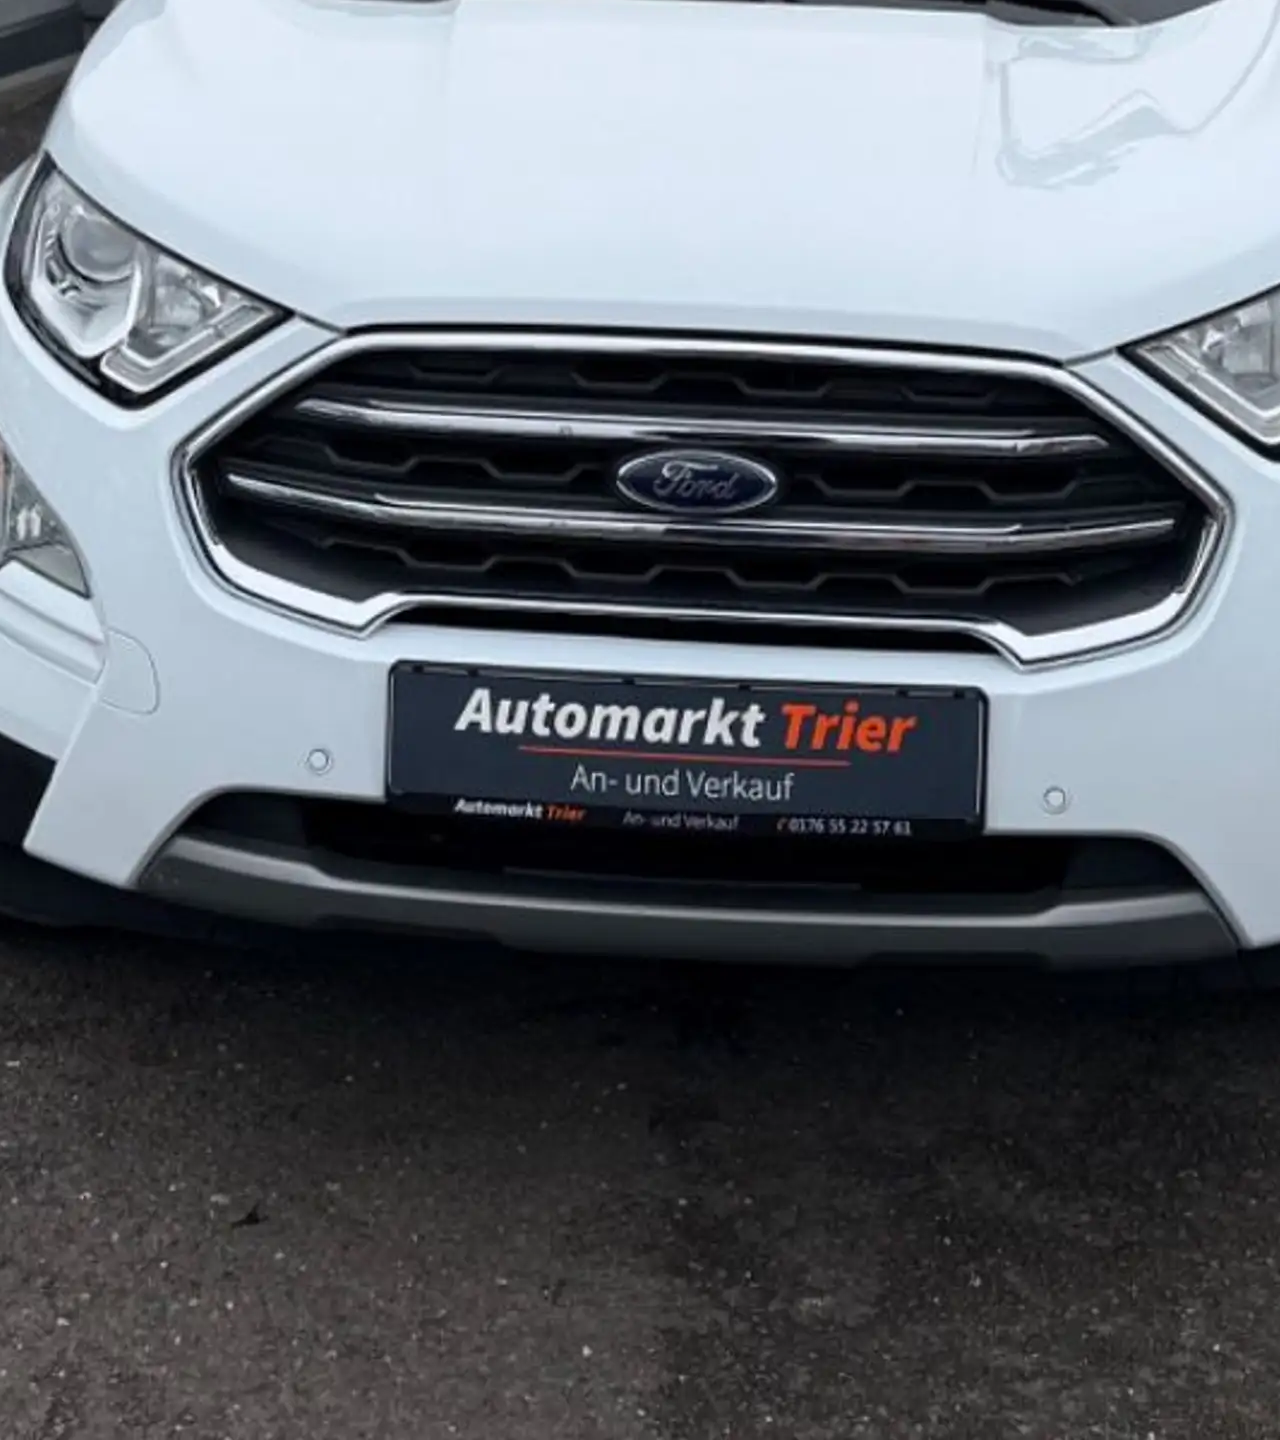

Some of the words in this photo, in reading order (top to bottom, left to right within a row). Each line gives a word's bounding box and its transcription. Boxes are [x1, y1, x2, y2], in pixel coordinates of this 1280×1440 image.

[653, 460, 740, 500] Ford
[454, 687, 766, 748] Automarkt
[780, 699, 917, 753] Trier
[570, 763, 618, 792] An-
[624, 768, 680, 797] und
[685, 769, 795, 801] Verkauf
[454, 798, 543, 820] Automarkt
[545, 804, 587, 822] Trier
[788, 817, 825, 834] 0176
[850, 818, 869, 835] 22
